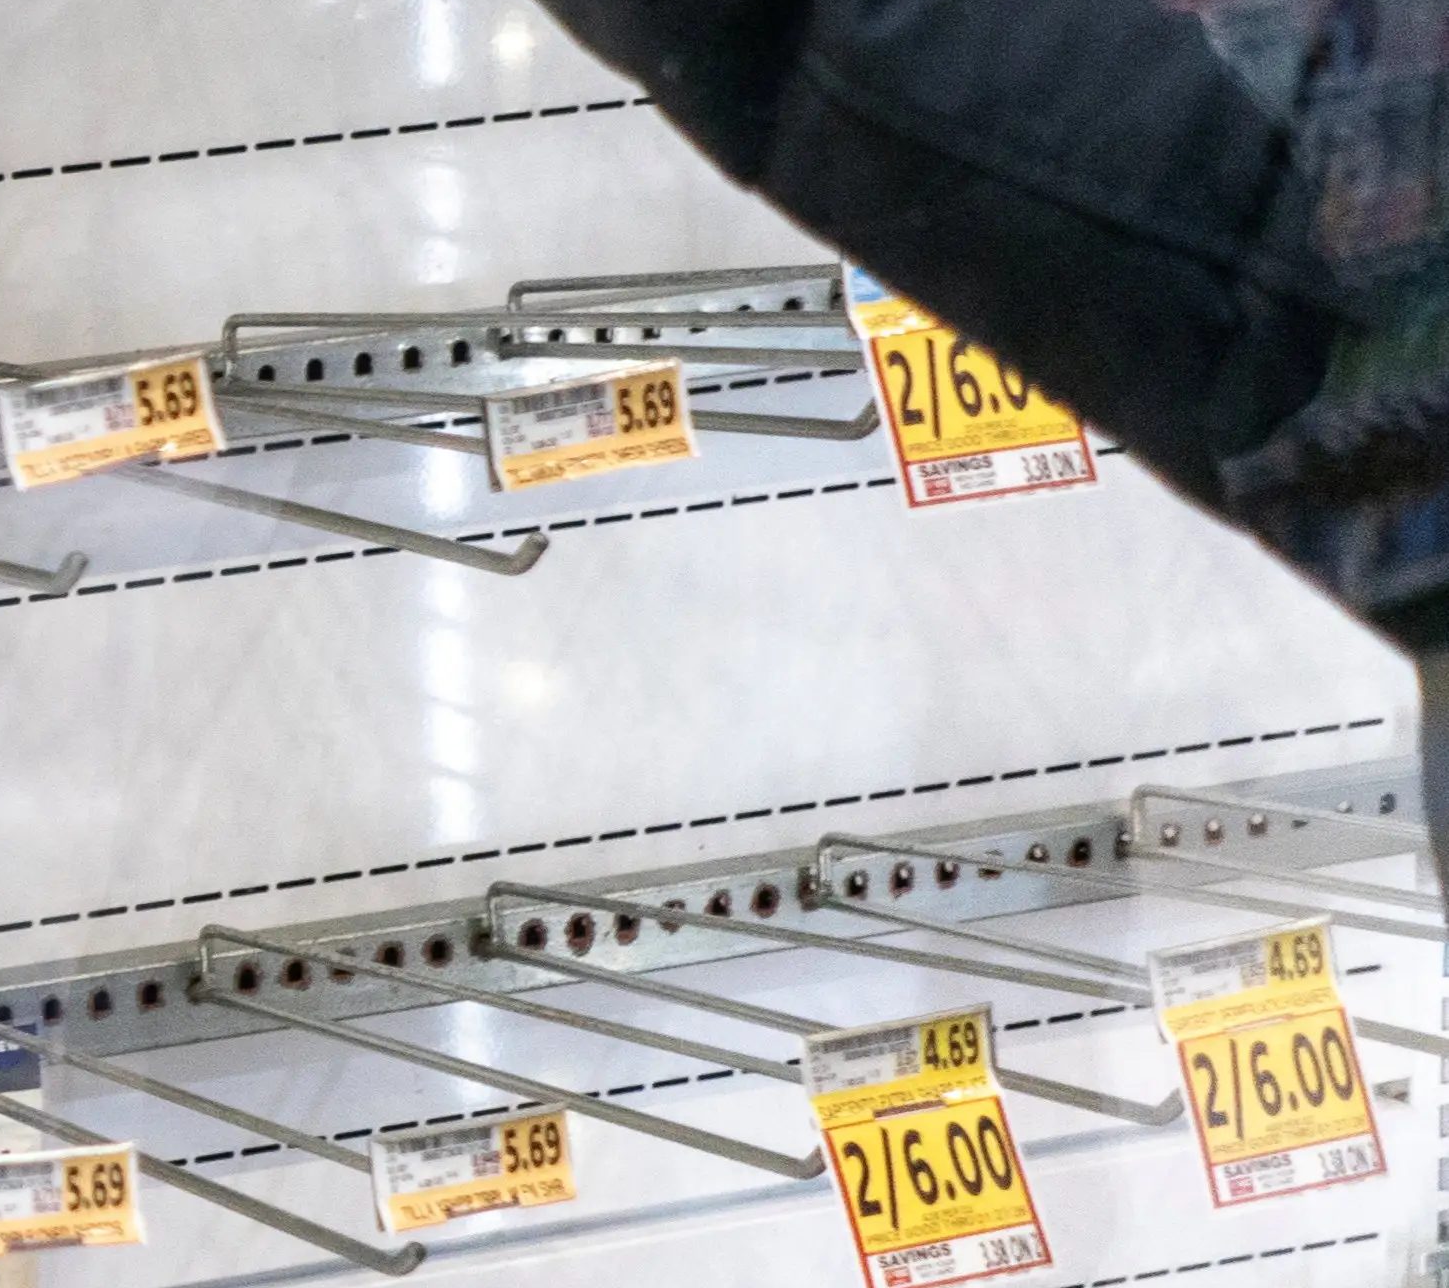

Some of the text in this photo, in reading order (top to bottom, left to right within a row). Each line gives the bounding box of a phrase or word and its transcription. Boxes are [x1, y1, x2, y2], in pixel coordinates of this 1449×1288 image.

[136, 371, 196, 425] 5.69
[617, 380, 674, 433] 5.69
[886, 337, 1028, 441] 2/6.0
[919, 456, 994, 477] SAVINGS
[1271, 932, 1324, 980] 4.69
[924, 1021, 979, 1069] 4.69
[1193, 1026, 1354, 1141] 2/6.00
[505, 1121, 561, 1173] 5.69
[1224, 1154, 1293, 1178] SAVINGS
[67, 1162, 125, 1212] 5.69
[843, 1115, 1013, 1231] 2/6.00
[878, 1243, 953, 1268] SAVINGS
